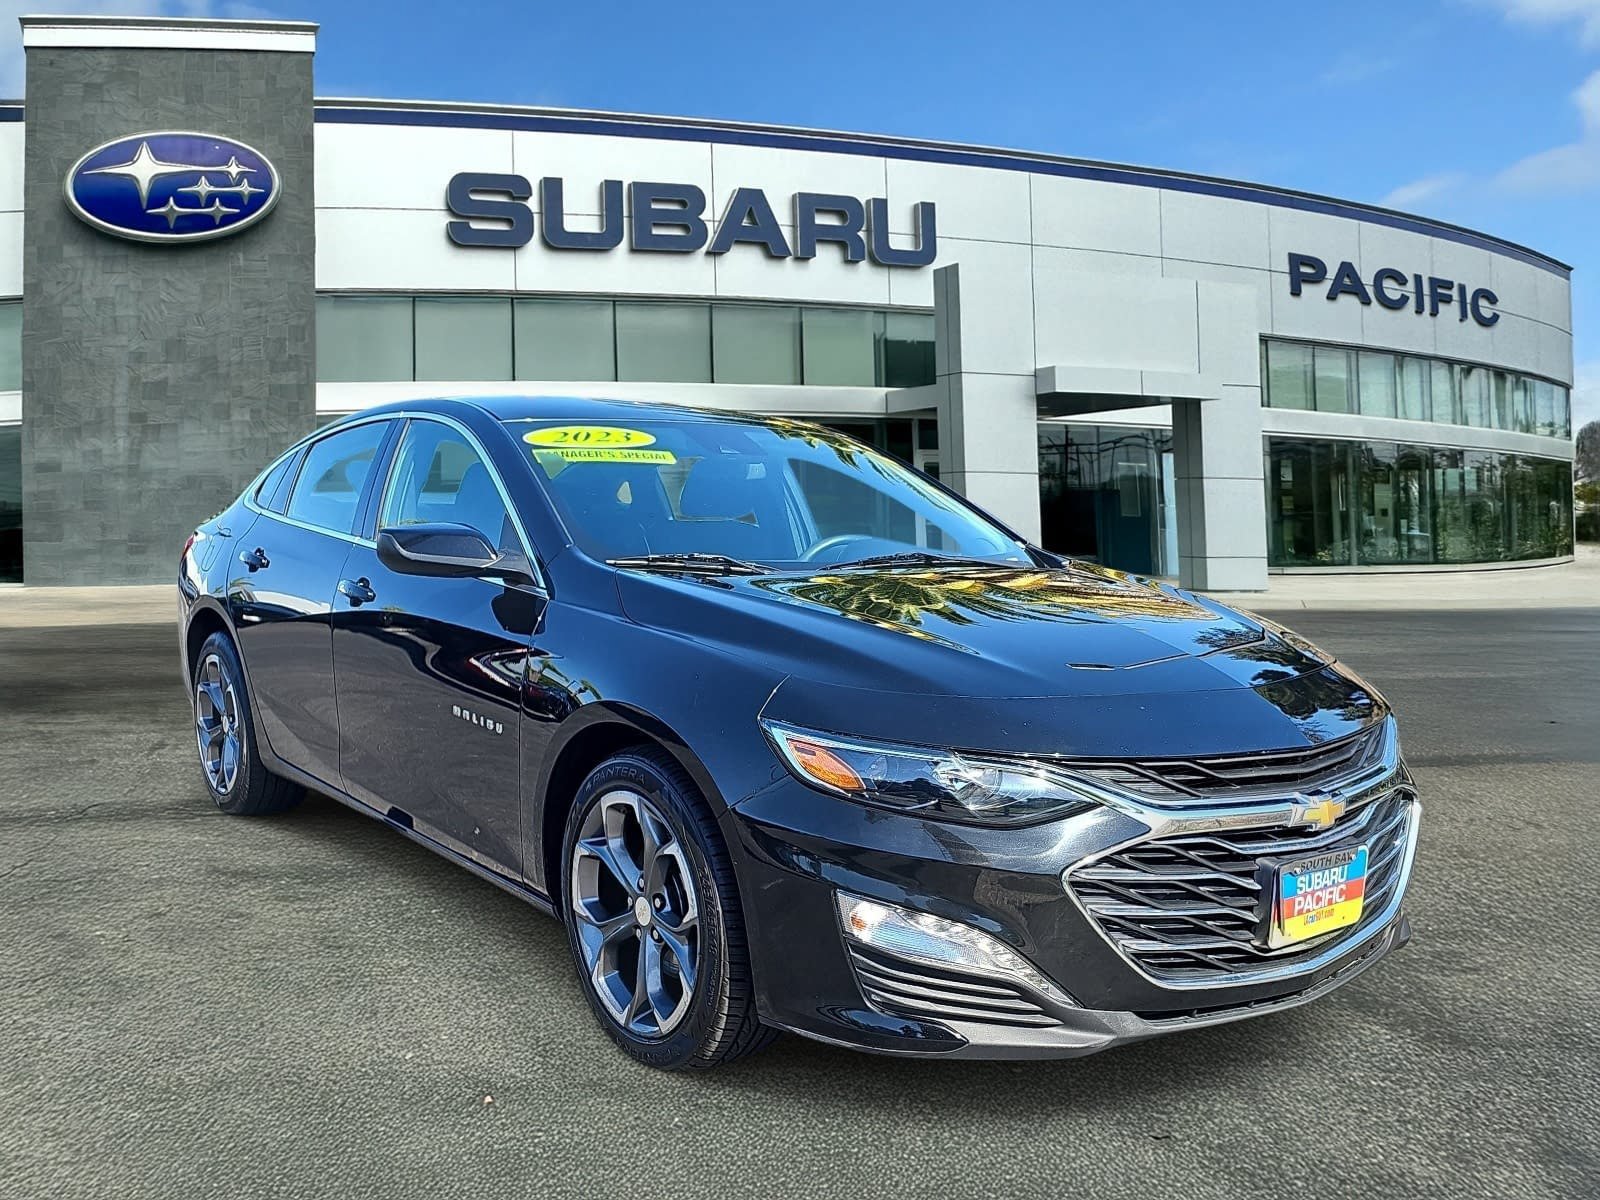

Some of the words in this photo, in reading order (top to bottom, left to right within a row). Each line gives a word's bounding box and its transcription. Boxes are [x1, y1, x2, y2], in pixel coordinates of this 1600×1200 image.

[447, 172, 937, 267] SUBARU
[1288, 252, 1500, 327] PACIFIC
[552, 431, 632, 443] 2023
[620, 451, 667, 460] SPECIAL
[1300, 855, 1333, 872] SOUTH
[1296, 864, 1348, 894] SUBARU
[1294, 884, 1347, 916] PACIFIC
